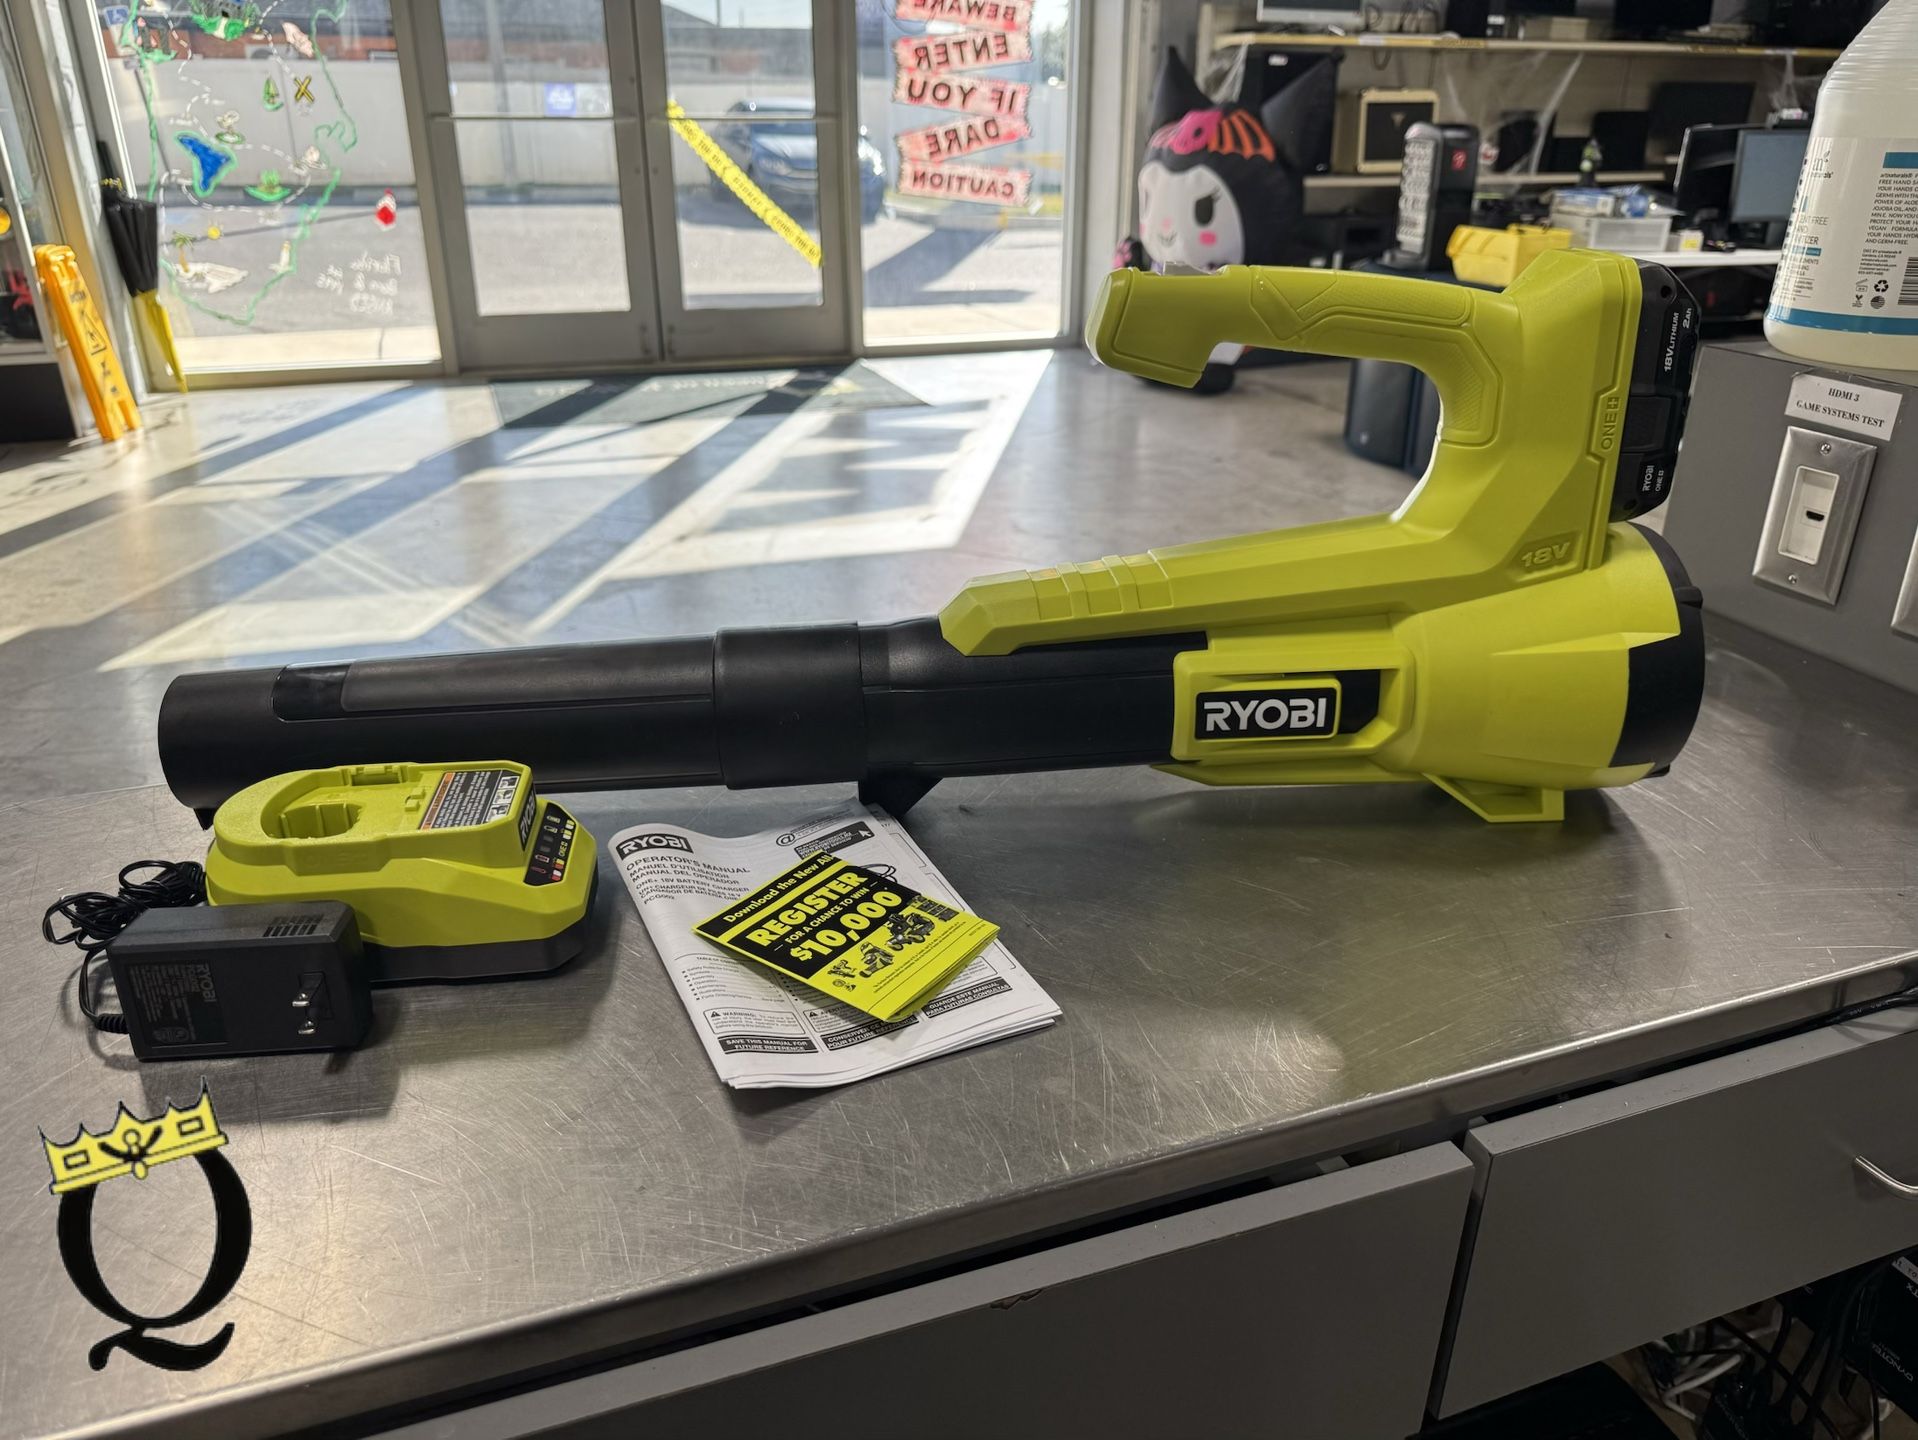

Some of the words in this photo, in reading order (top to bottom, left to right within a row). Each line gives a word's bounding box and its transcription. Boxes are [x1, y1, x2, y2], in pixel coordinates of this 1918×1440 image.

[1828, 387, 1853, 401] HDMI
[1853, 393, 1860, 402] 3
[1796, 399, 1821, 413] GAME
[1822, 406, 1860, 422] SYSTEMS
[1861, 415, 1885, 428] TEST
[1642, 464, 1655, 493] RYOBI
[1521, 542, 1571, 568] 18V
[1203, 698, 1328, 732] RYOBI
[620, 835, 689, 855] RYOBI
[626, 855, 701, 871] OPERATOR'S
[702, 862, 751, 874] MANUAL
[629, 863, 669, 878] MANUEL
[670, 863, 730, 879] D'UTILISATION
[632, 869, 673, 883] MANUAL
[674, 869, 692, 877] DEL
[692, 872, 740, 885] OPERADOR
[676, 878, 710, 887] BATTERY
[711, 884, 750, 892] CHARGER
[723, 887, 780, 923] Download
[776, 875, 797, 894] the
[796, 863, 820, 885] New
[745, 871, 869, 948] REGISTER
[785, 928, 804, 945] FOR
[803, 922, 813, 934] A
[810, 901, 844, 929] CHANCE
[840, 895, 854, 907] TO
[850, 886, 871, 902] WIN
[790, 890, 902, 963] $10,000
[197, 962, 216, 1003] RYOBI
[929, 996, 957, 1010] GUARDE
[956, 990, 973, 1001] ESTE
[972, 982, 1000, 994] MANUAL
[925, 1005, 944, 1016] PARA
[943, 996, 975, 1010] FUTURAS
[973, 984, 1010, 1000] CONSULTAS
[827, 1027, 871, 1043] CONSERVER
[827, 1040, 849, 1049] POUR
[848, 1031, 877, 1044] FUTURE
